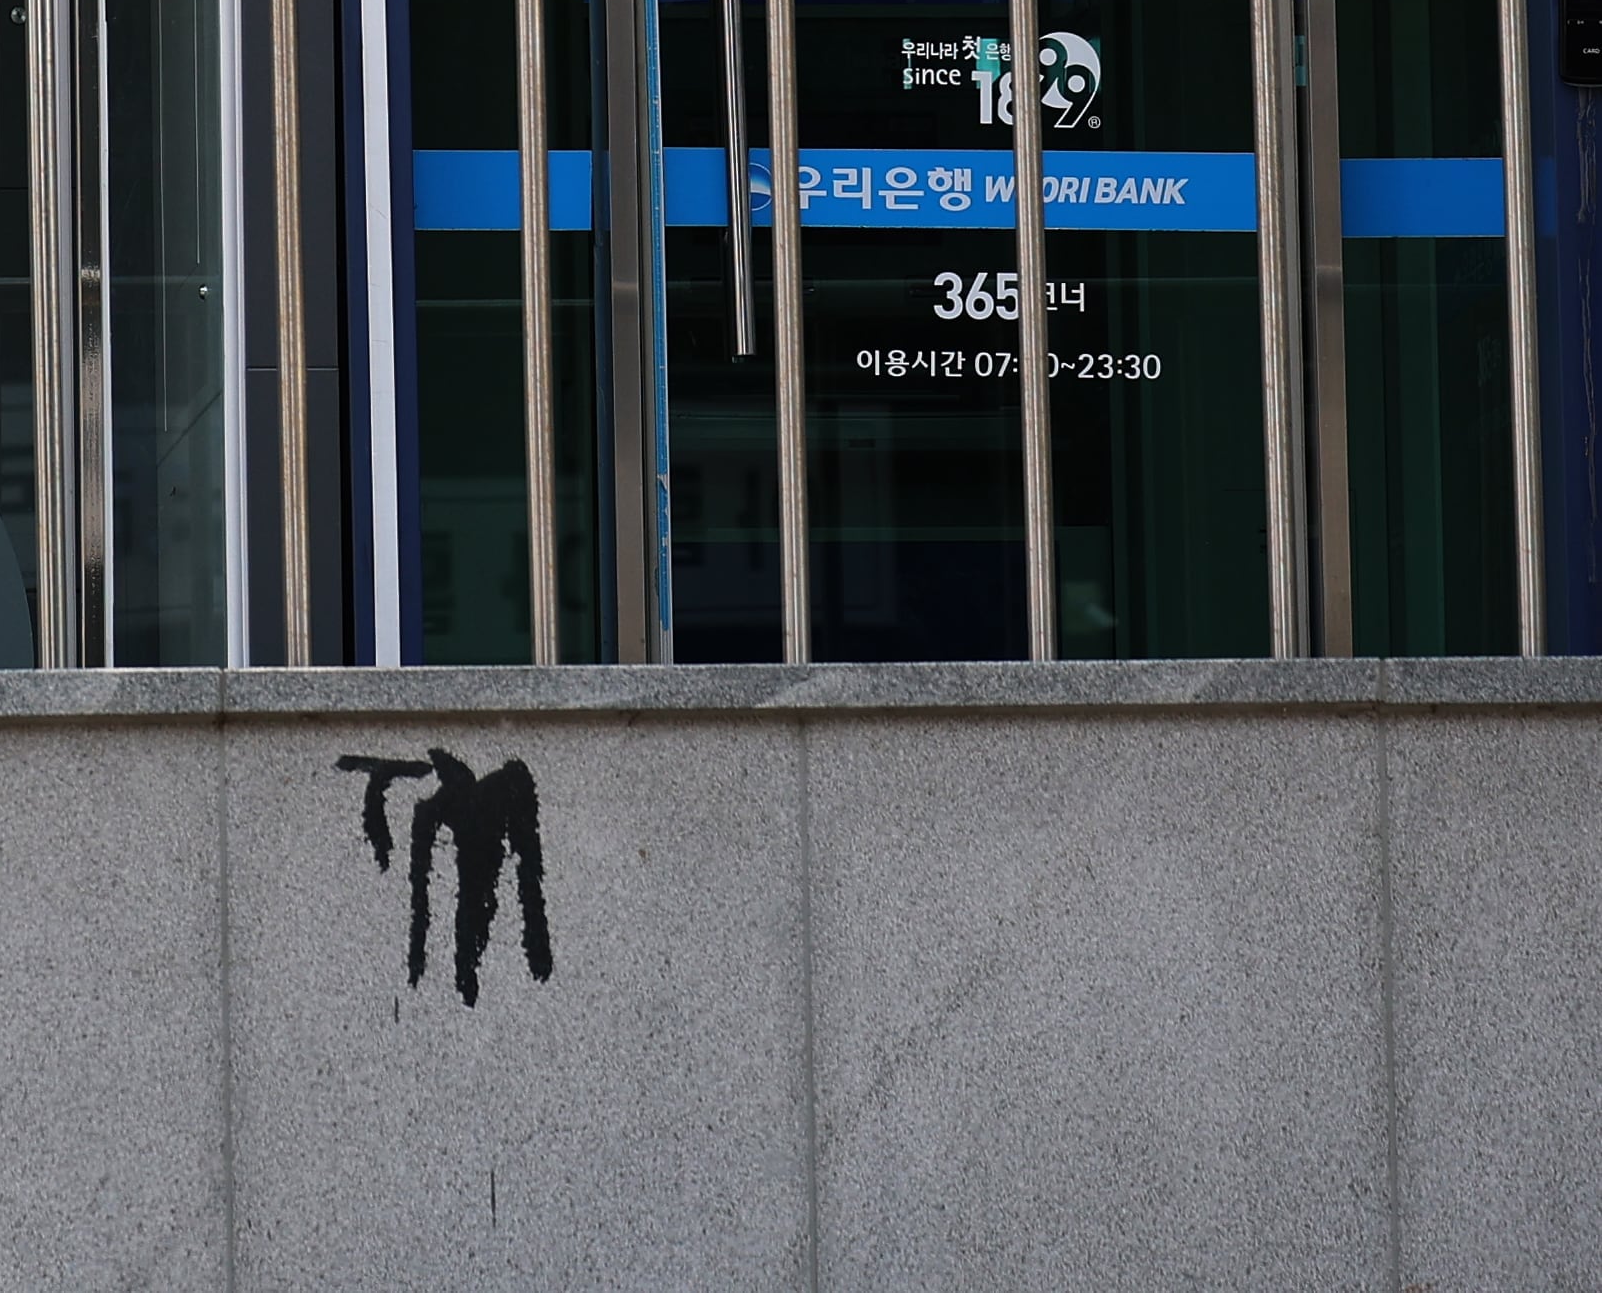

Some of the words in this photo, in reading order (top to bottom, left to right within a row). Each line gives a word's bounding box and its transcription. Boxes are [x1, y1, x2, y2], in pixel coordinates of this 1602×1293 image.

[901, 42, 958, 59] 우리나라
[962, 35, 980, 60] 첫
[798, 166, 973, 212] 우리은행
[985, 176, 1090, 205] WORI
[1094, 177, 1188, 205] BANK
[856, 350, 966, 378] 이용시간
[974, 352, 1161, 380] 07:~23:30
